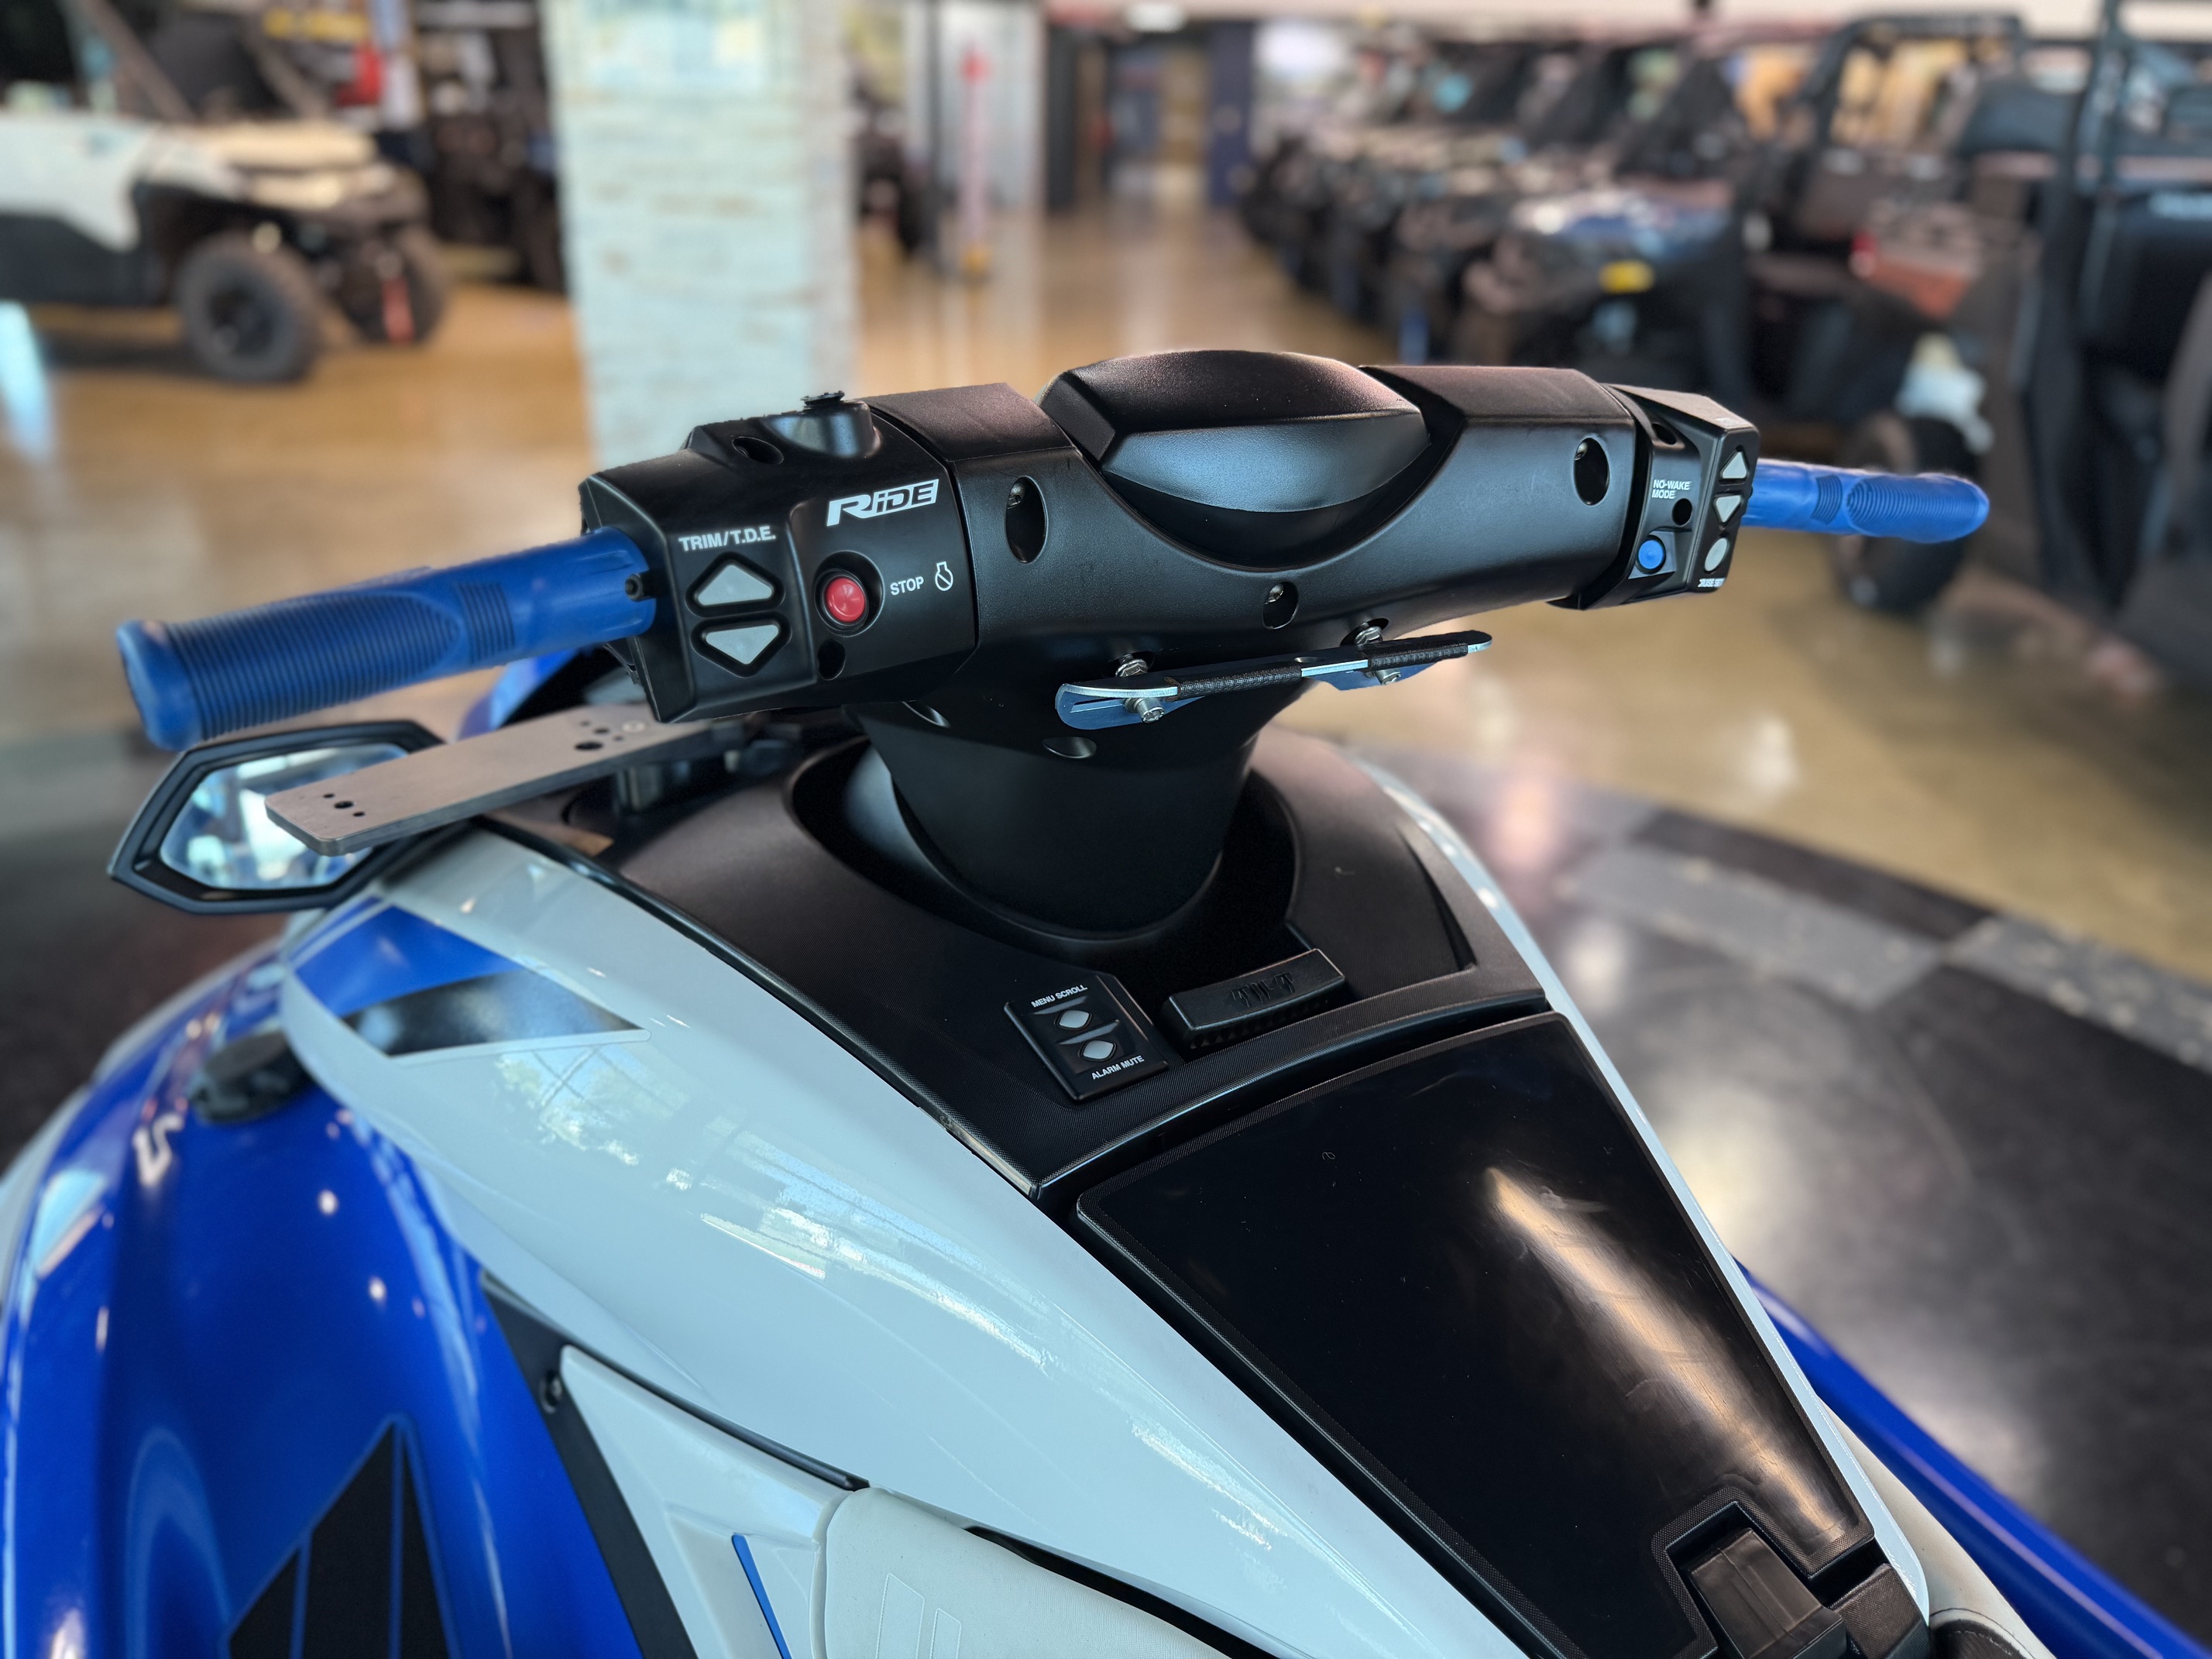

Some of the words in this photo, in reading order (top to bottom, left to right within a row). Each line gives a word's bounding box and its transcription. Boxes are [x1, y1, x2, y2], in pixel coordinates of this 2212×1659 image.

[1651, 489, 1676, 500] MODE
[1653, 479, 1692, 490] NO-WAKE
[891, 576, 924, 596] STOP
[1031, 996, 1055, 1008] MENU
[1055, 984, 1087, 1000] SCROLL
[1091, 1063, 1121, 1080] ALARM
[1121, 1056, 1145, 1069] MUTE
